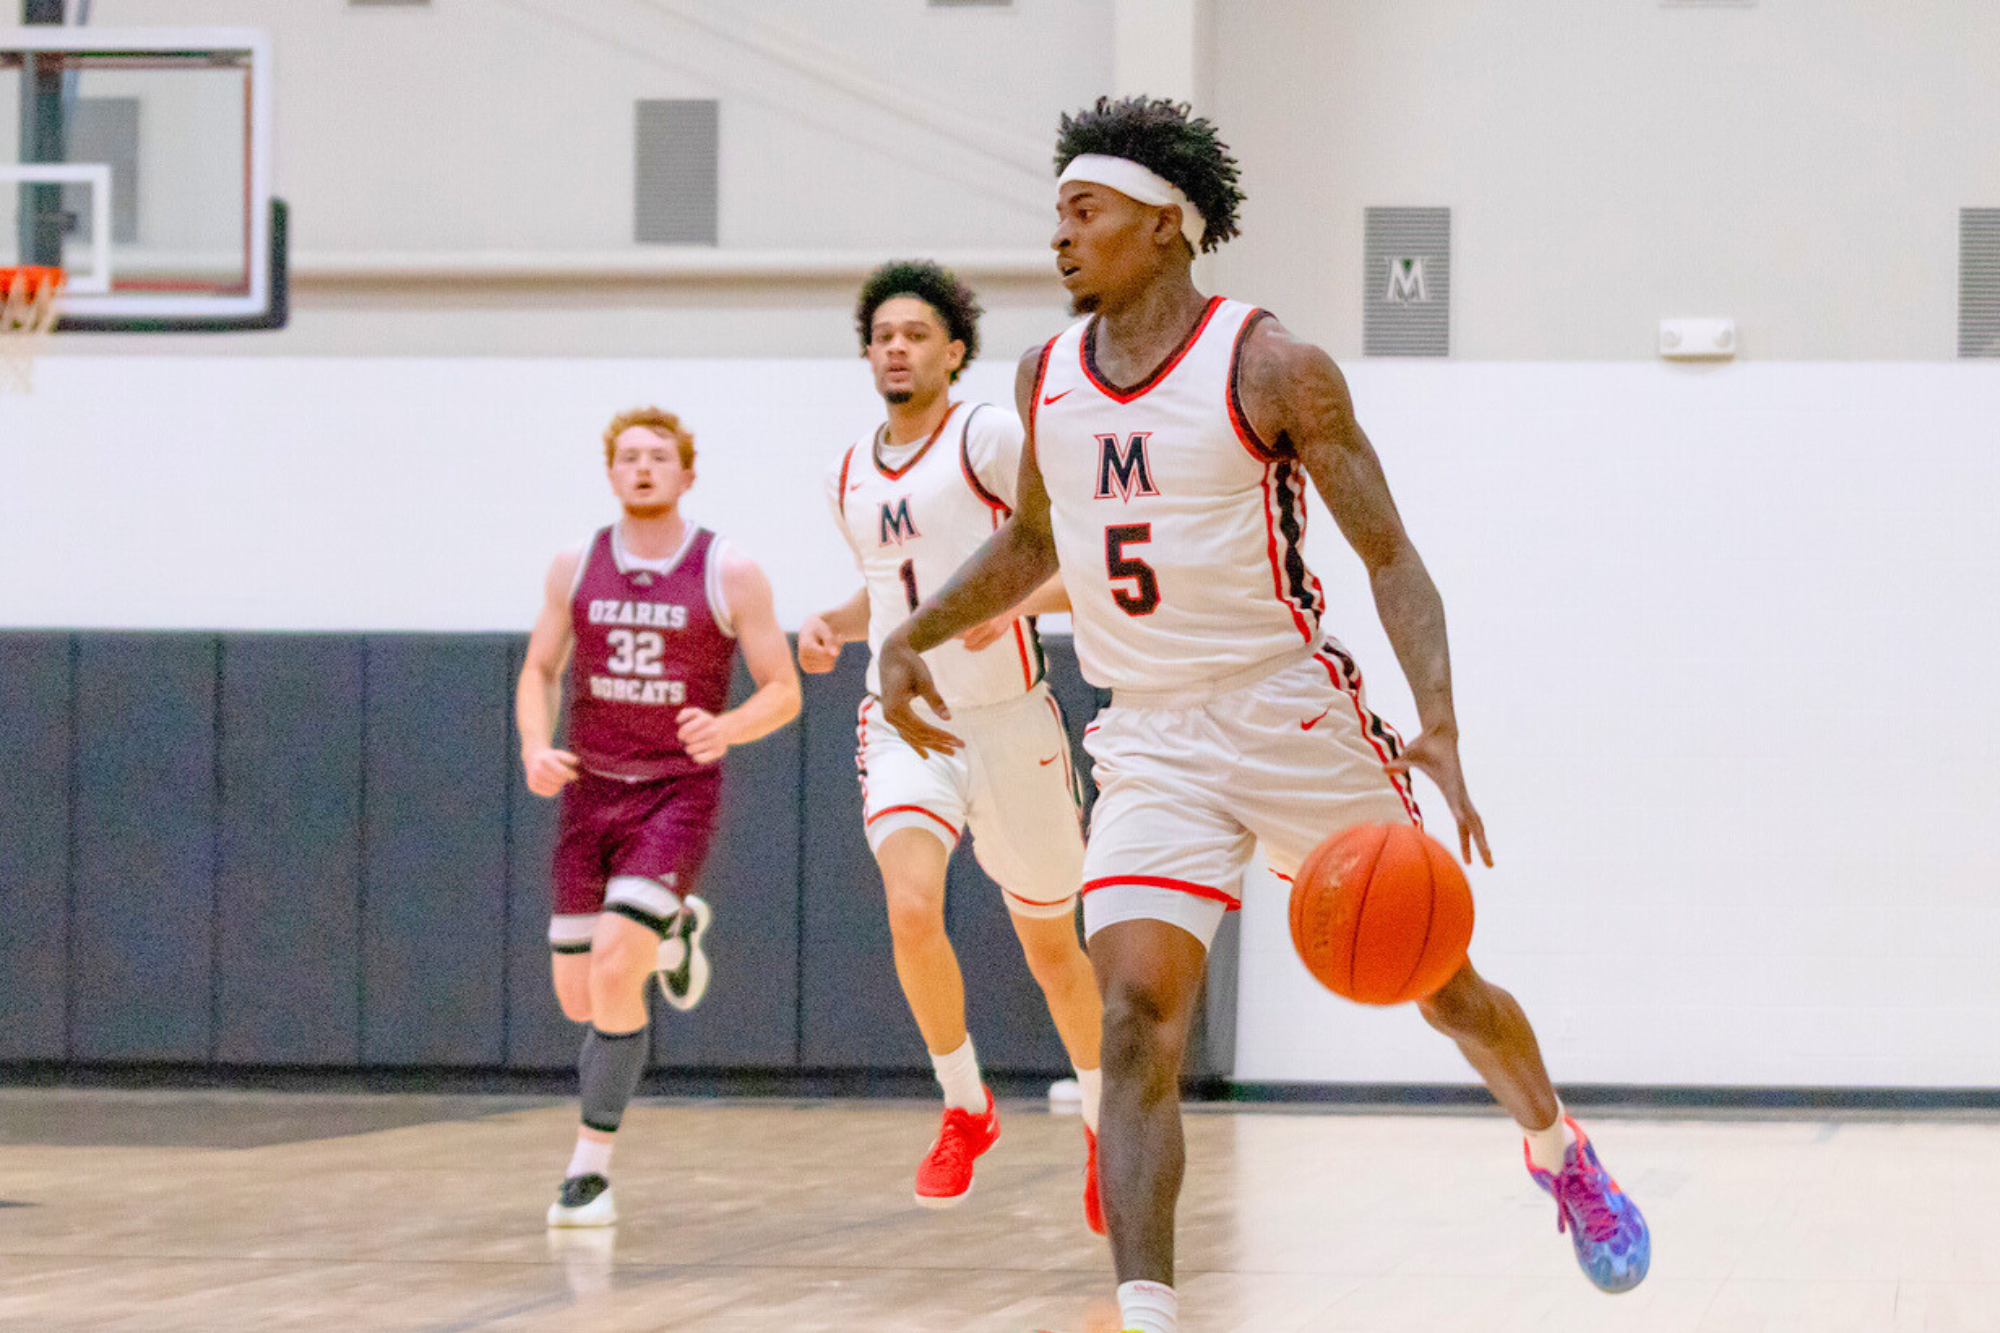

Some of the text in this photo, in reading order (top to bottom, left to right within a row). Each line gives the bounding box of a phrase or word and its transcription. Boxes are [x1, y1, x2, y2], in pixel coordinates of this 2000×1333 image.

[1384, 255, 1429, 307] M
[1093, 431, 1161, 504] M
[877, 493, 922, 548] M
[898, 558, 920, 614] 1
[1105, 522, 1161, 617] 5
[588, 599, 688, 629] OZARKS
[606, 629, 664, 675] 32
